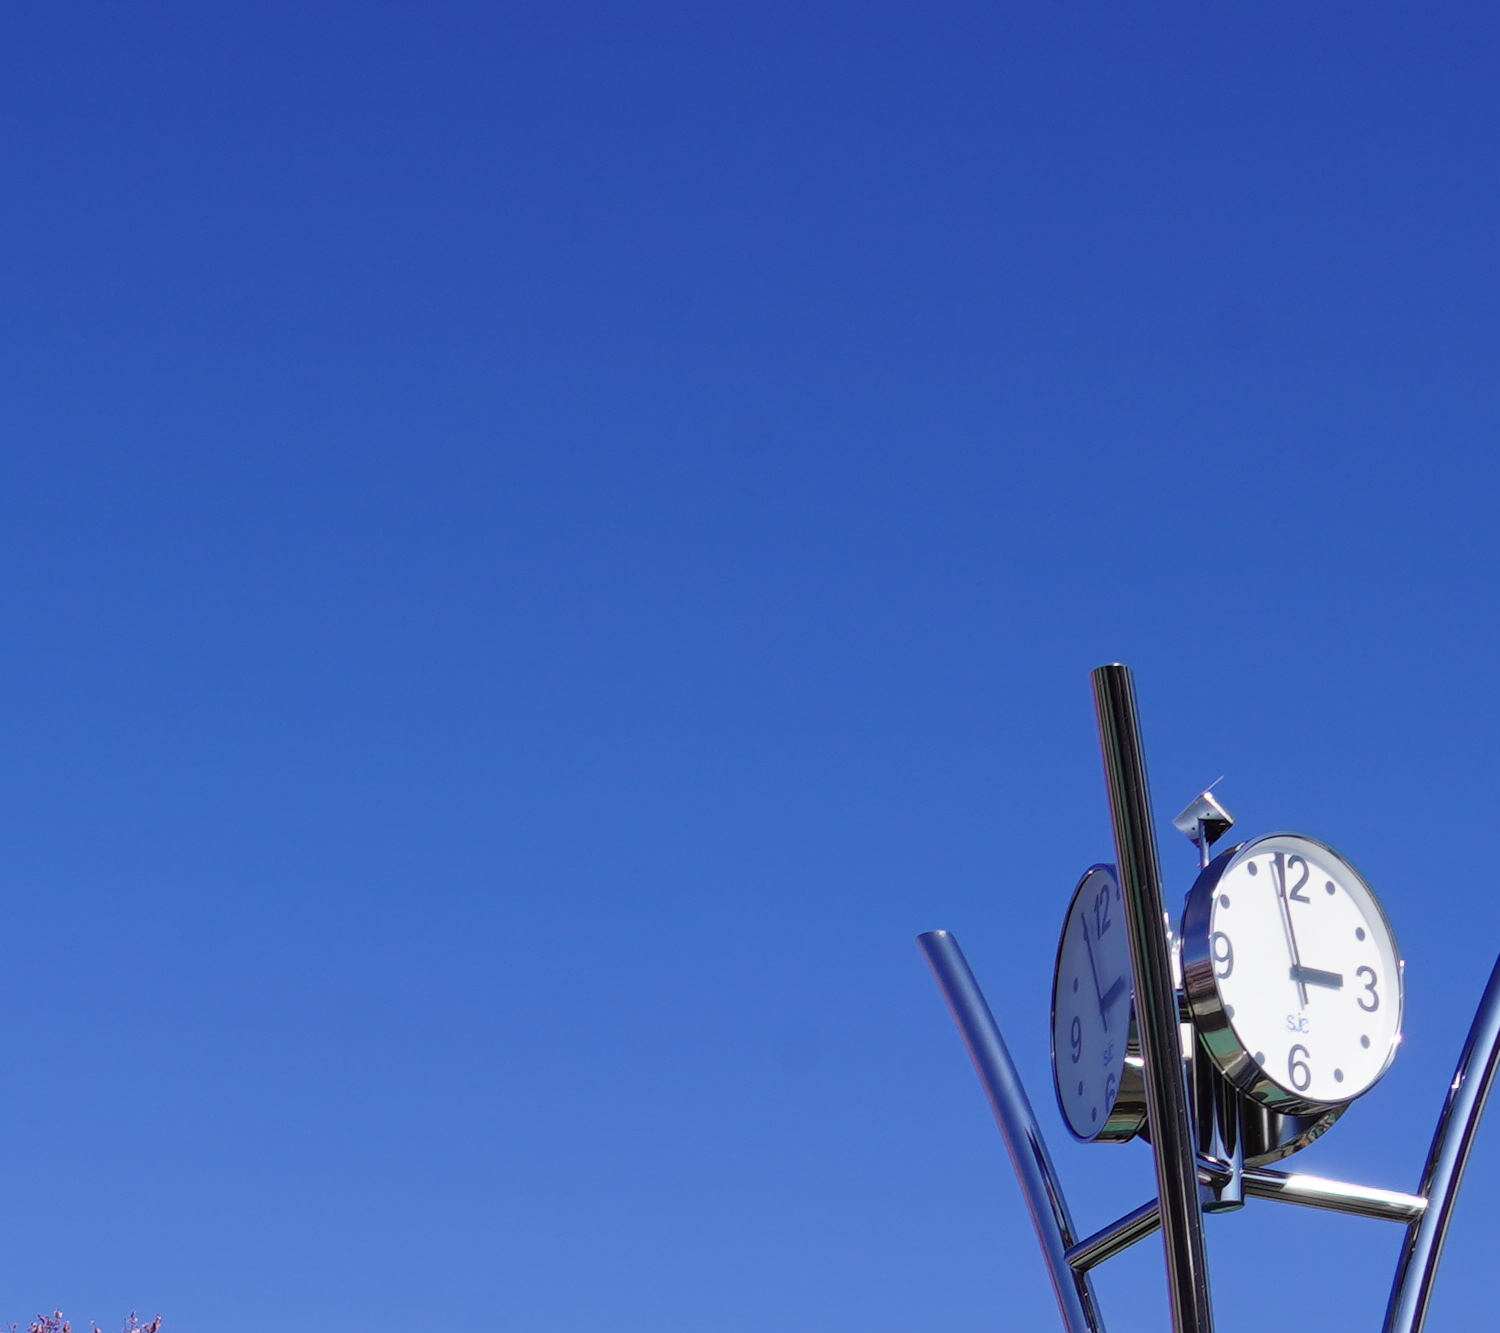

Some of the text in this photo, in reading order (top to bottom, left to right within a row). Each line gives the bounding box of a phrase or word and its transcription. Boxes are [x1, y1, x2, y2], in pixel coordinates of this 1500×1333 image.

[1094, 884, 1112, 940] 12
[1210, 931, 1234, 979] 9
[1356, 965, 1380, 1013] 3
[1071, 1015, 1082, 1063] 9
[1288, 1044, 1312, 1092] 6
[1105, 1072, 1116, 1114] 6
